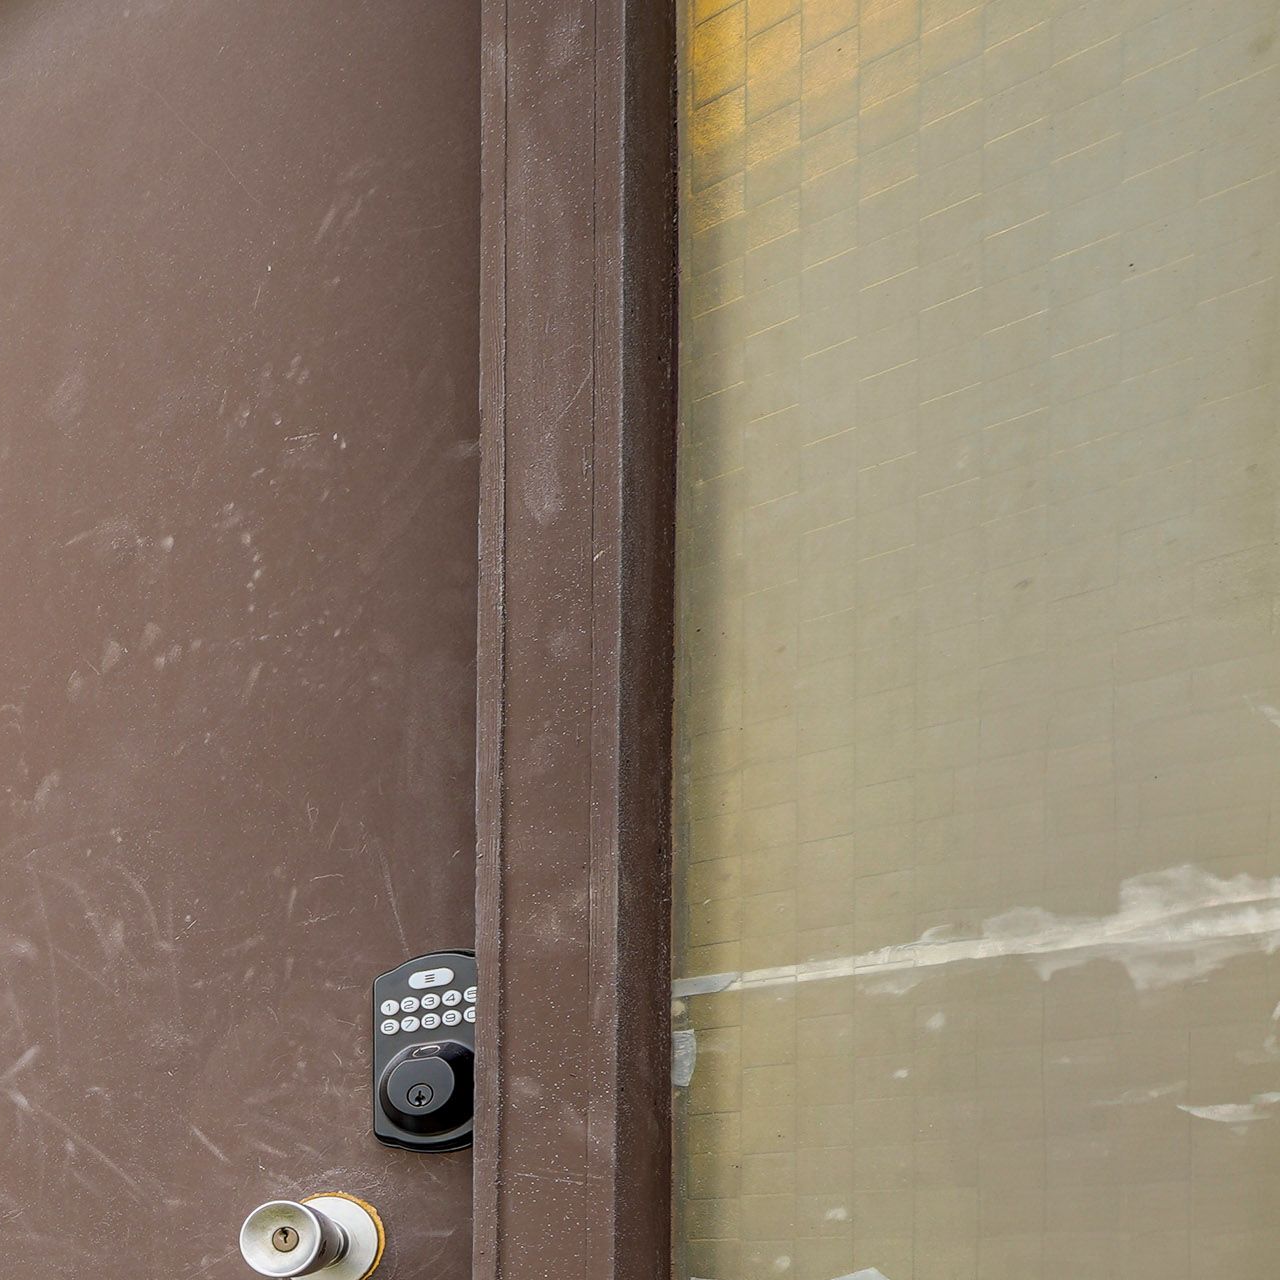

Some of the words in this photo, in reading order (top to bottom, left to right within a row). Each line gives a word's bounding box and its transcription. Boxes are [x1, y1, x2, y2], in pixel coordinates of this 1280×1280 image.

[403, 1000, 414, 1009] 2
[424, 996, 435, 1006] 3
[445, 993, 455, 1002] 4
[383, 1022, 394, 1031] 6
[404, 1019, 414, 1029] 7
[424, 1016, 435, 1026] 8
[445, 1013, 456, 1023] 9
